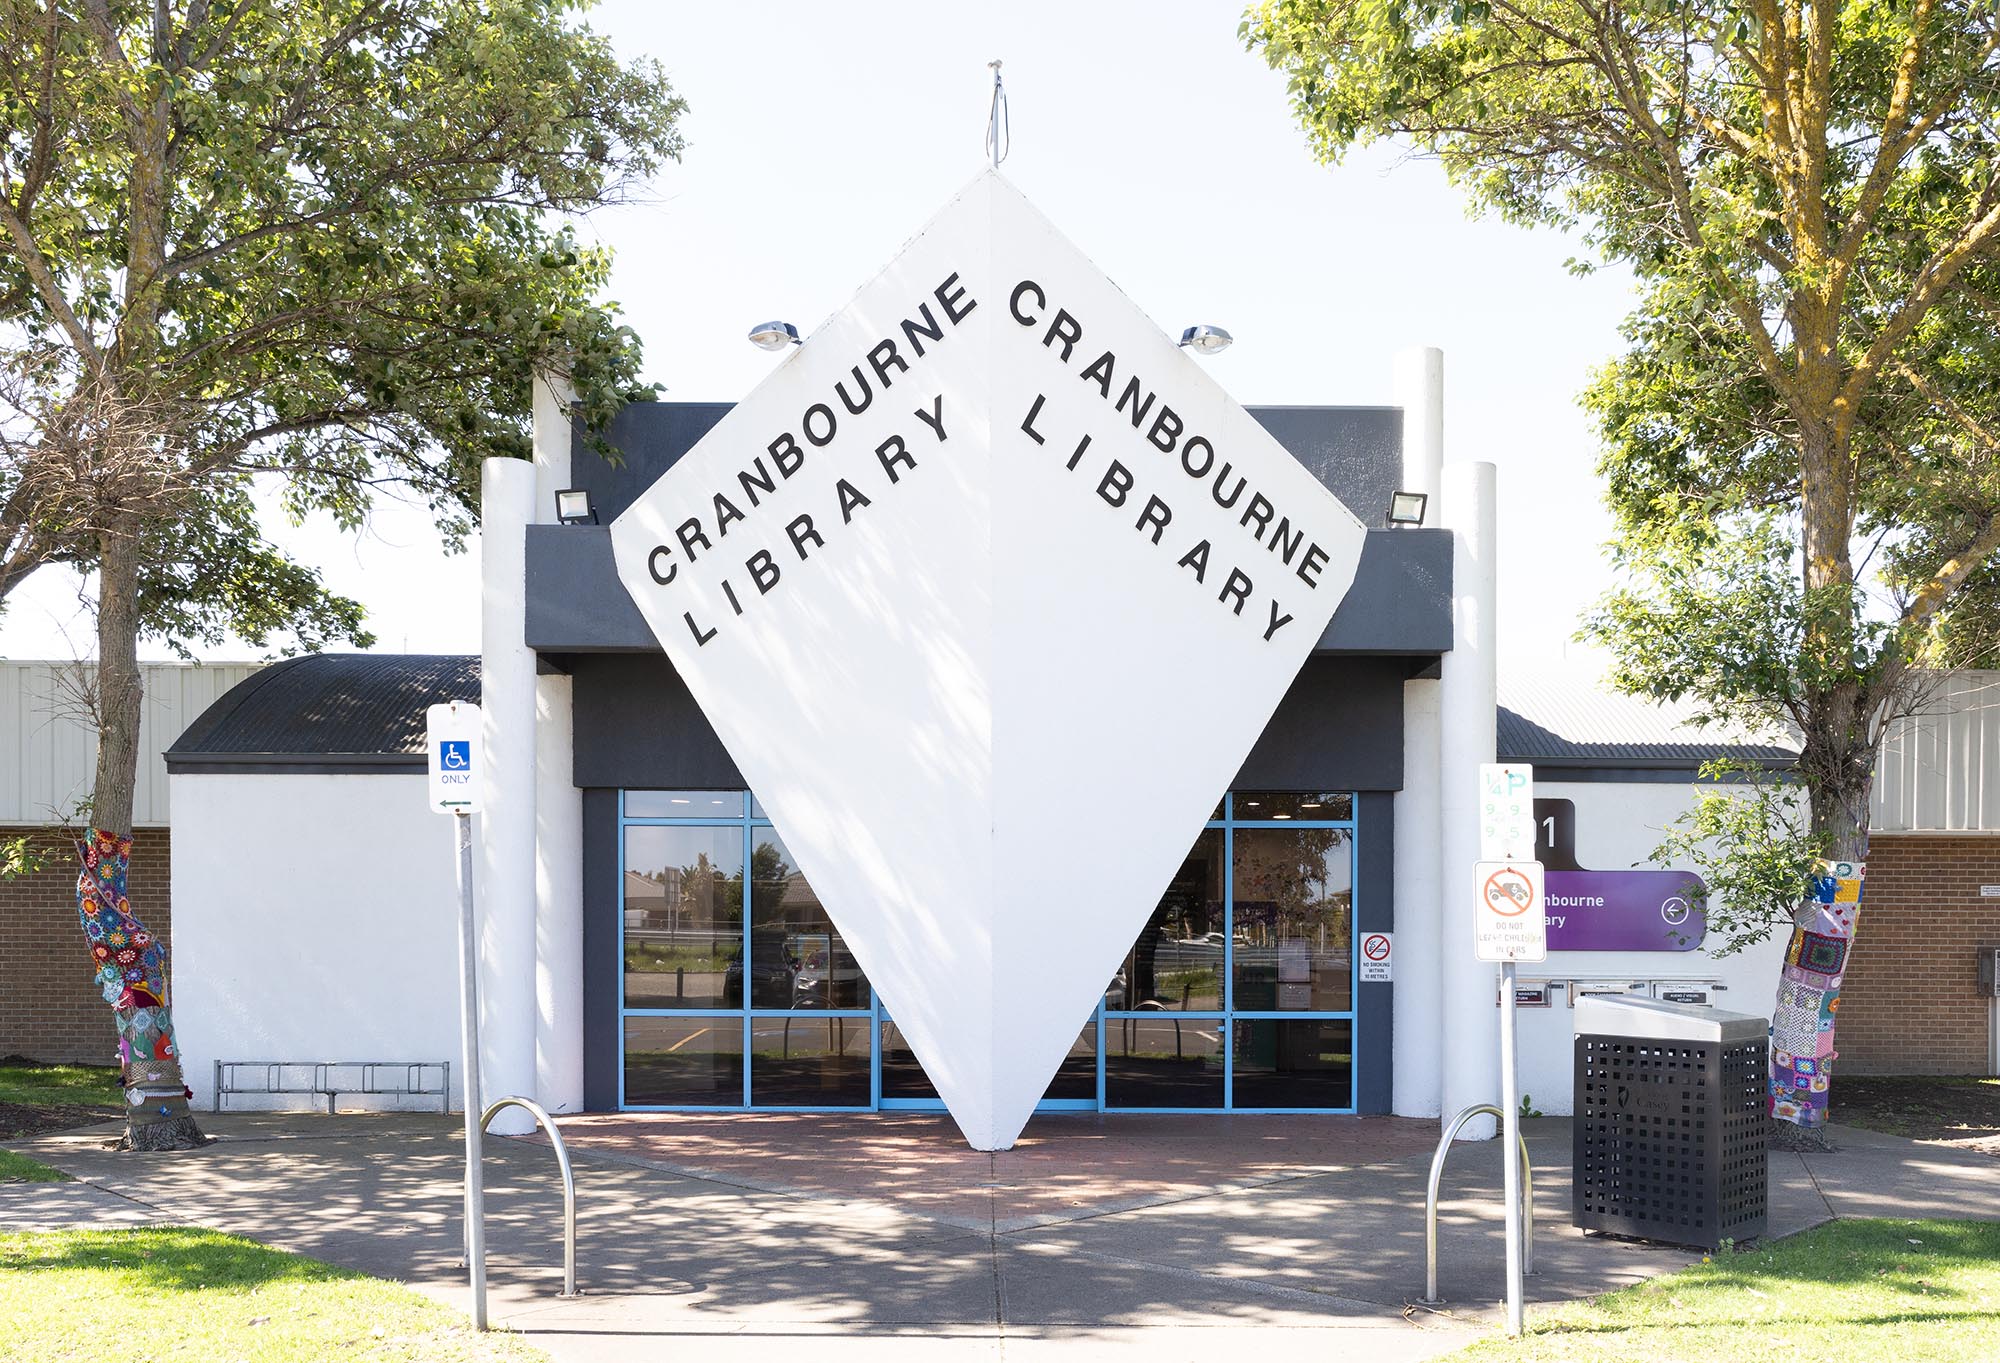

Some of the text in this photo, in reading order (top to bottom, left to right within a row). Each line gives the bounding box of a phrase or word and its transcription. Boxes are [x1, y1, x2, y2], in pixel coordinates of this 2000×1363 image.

[648, 271, 978, 586] CRANBOURNE
[1009, 280, 1330, 590] CRANBOURNE
[683, 393, 948, 647] LIBRARY
[1020, 393, 1294, 642] LIBRARY
[441, 774, 471, 785] ONLY
[1508, 772, 1527, 797] P
[1496, 922, 1524, 930] DO NOT
[1506, 946, 1526, 954] CARS
